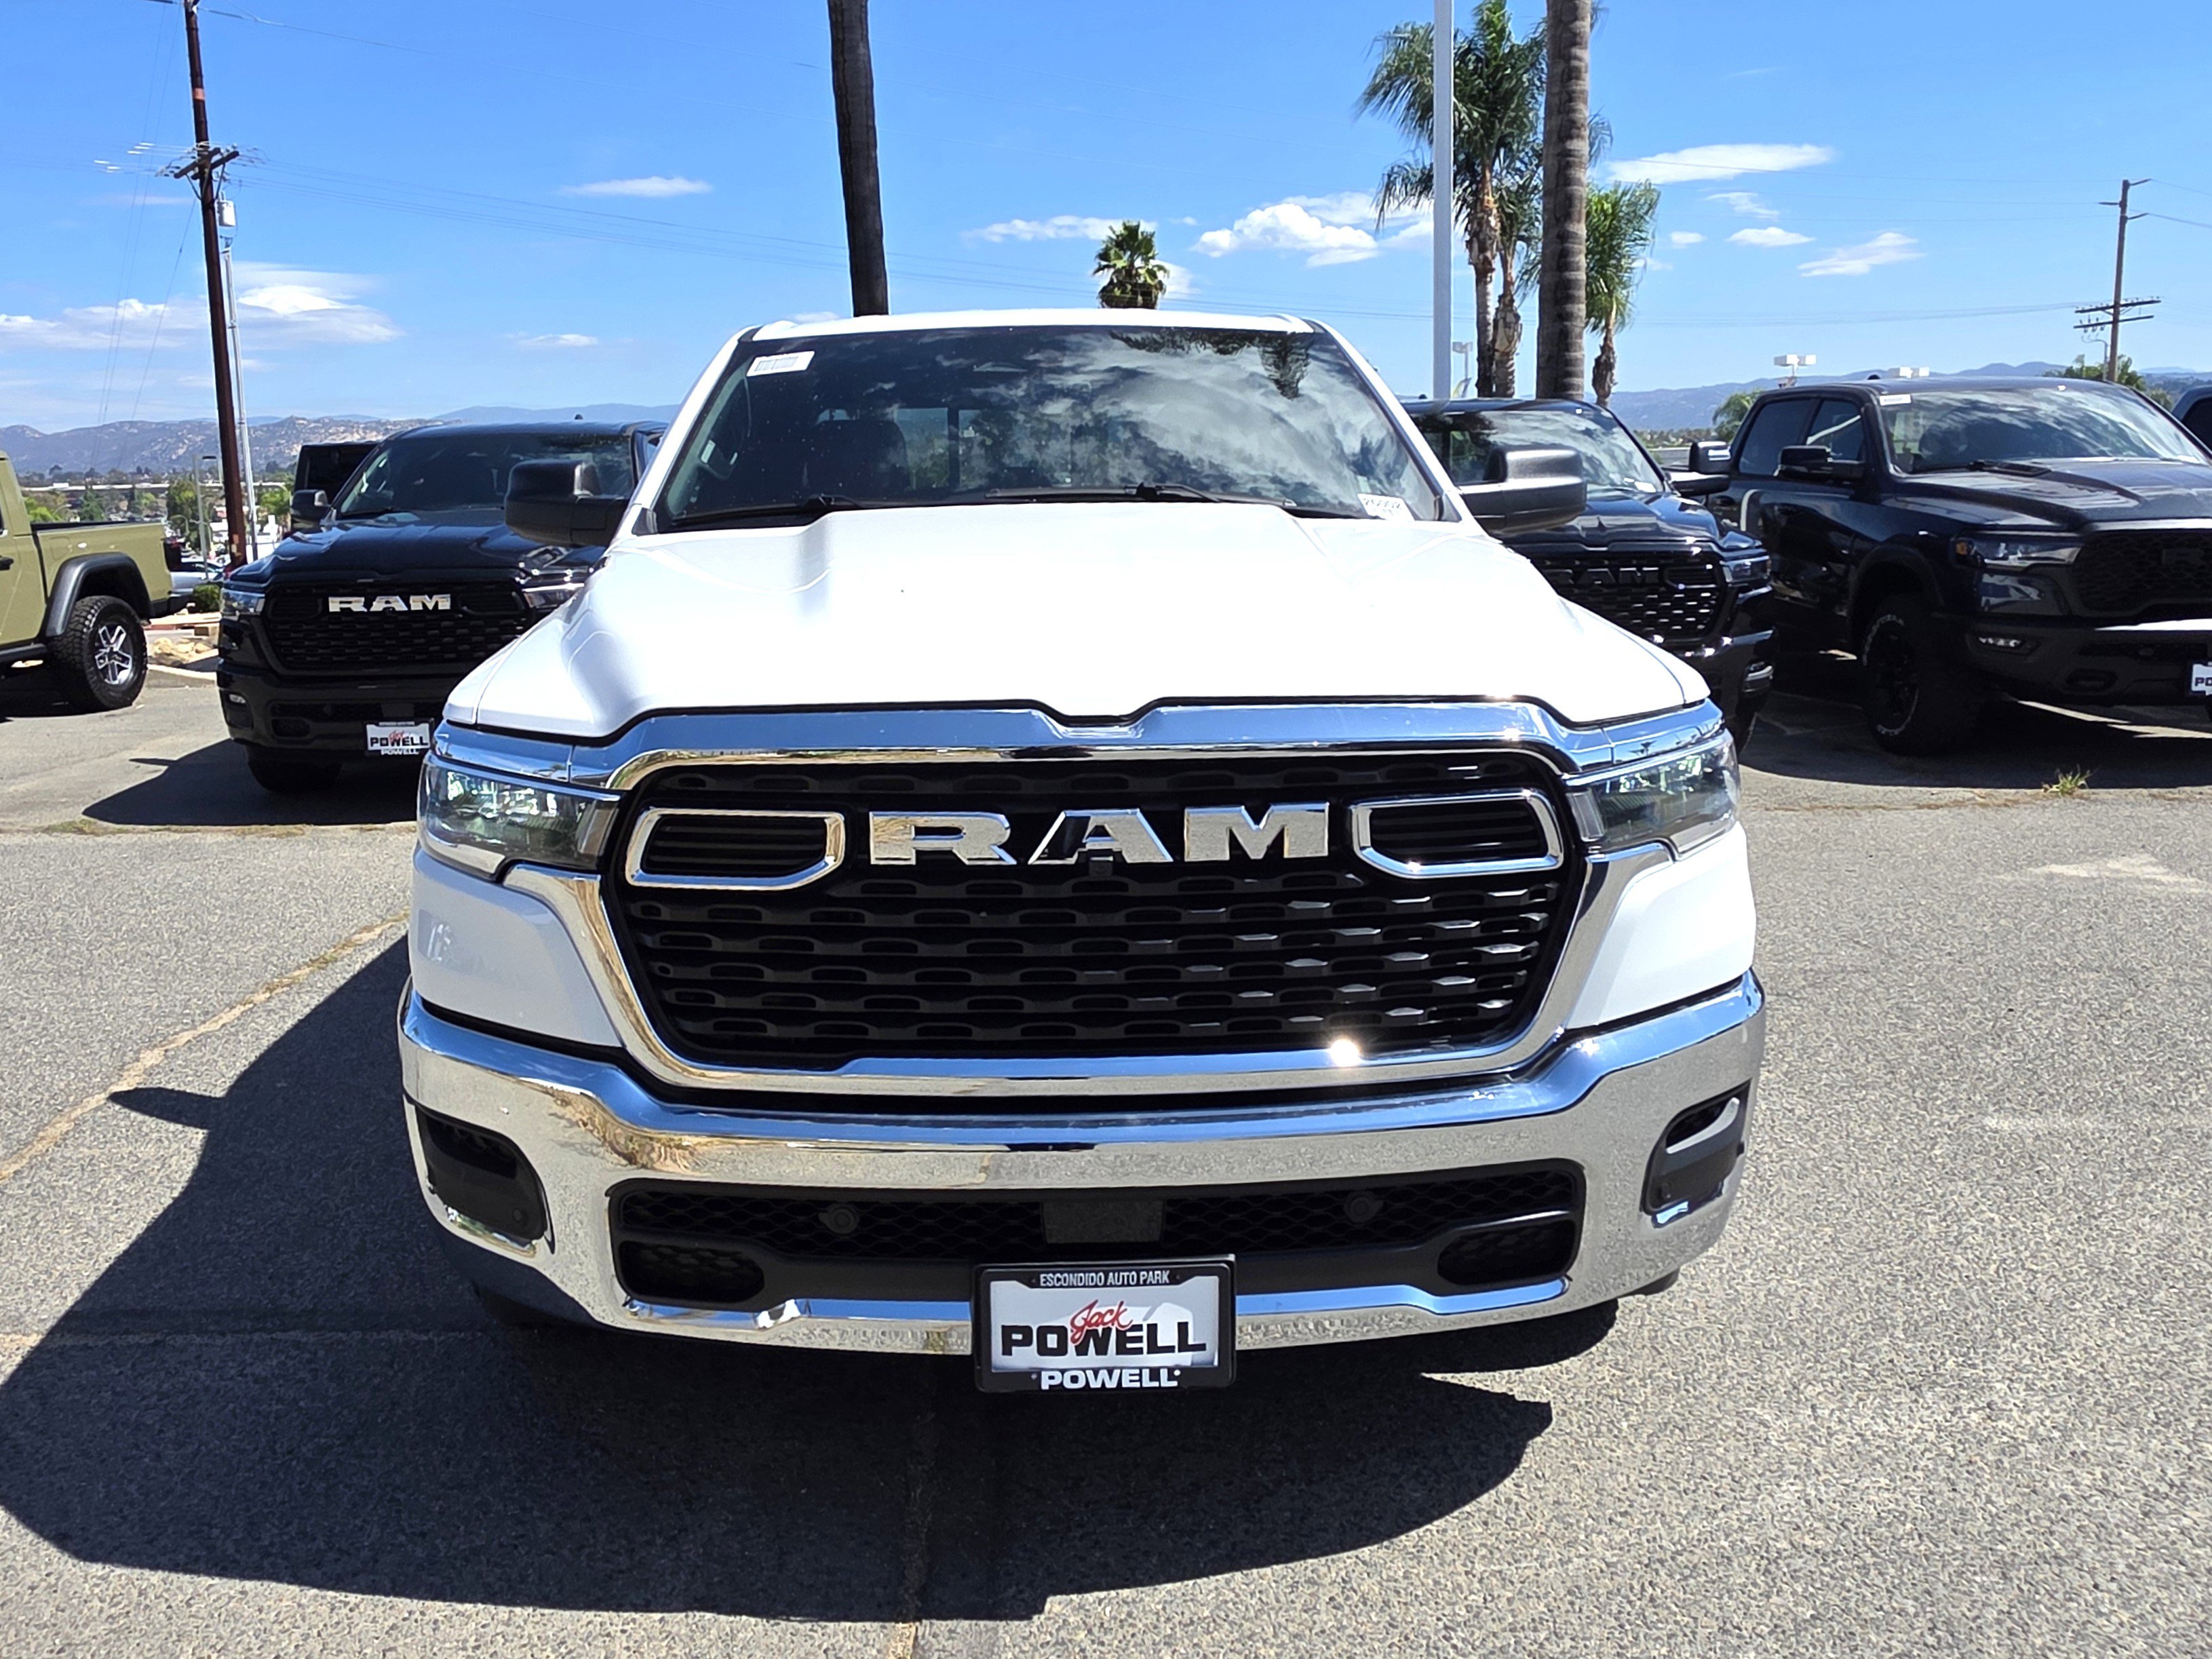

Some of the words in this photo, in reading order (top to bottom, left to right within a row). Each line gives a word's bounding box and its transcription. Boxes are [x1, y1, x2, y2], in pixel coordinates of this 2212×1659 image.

[328, 594, 450, 612] RAM
[370, 736, 428, 747] POWELL
[870, 802, 1330, 865] RAM
[1040, 1272, 1104, 1286] ESCONDIDO
[1107, 1270, 1137, 1285] AUTO
[1140, 1270, 1170, 1284] PARK
[1070, 1299, 1133, 1346] Jack
[1001, 1321, 1206, 1357] POWELL
[1041, 1367, 1178, 1390] POWELL
